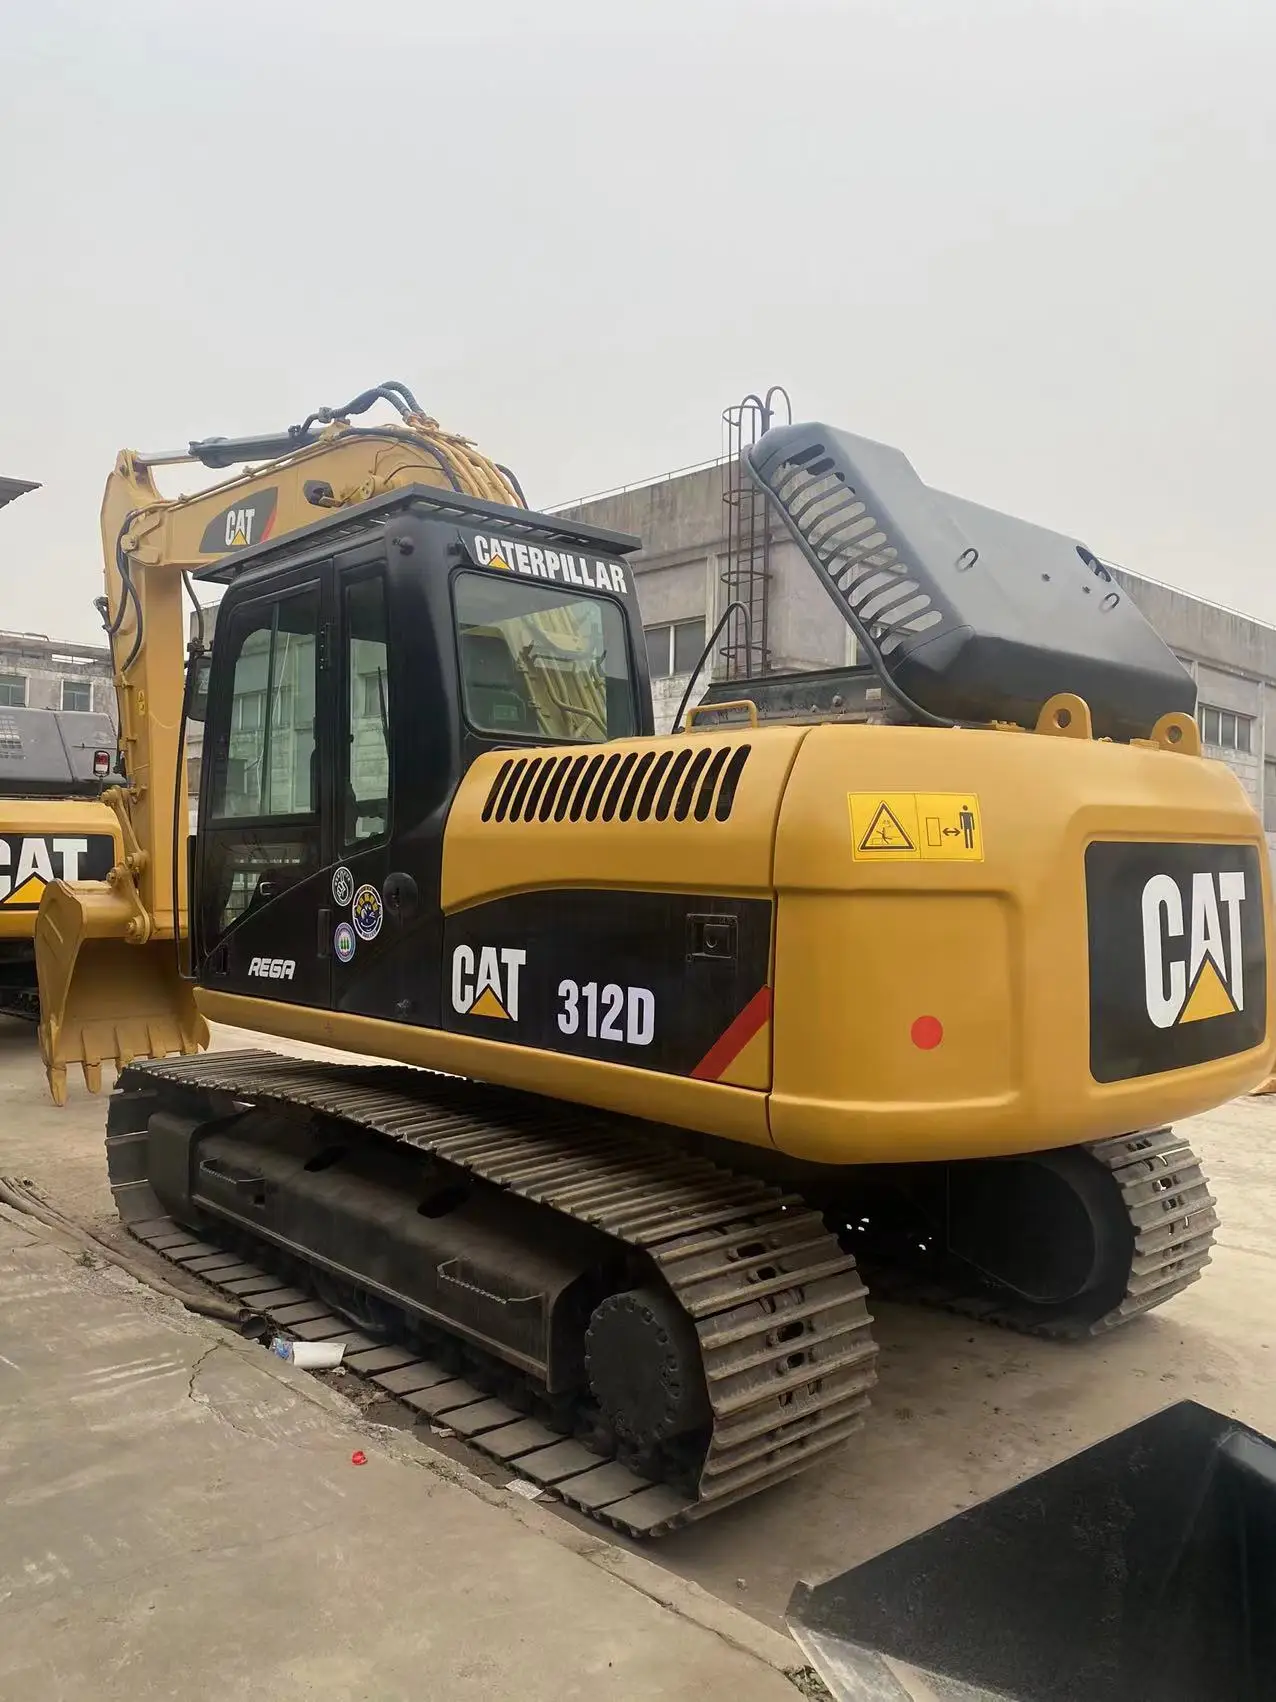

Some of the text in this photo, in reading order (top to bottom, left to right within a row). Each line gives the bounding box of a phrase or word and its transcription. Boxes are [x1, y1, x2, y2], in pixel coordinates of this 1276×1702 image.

[225, 509, 255, 546] CAT
[474, 535, 628, 594] CATERPILLAR
[452, 945, 526, 1022] CAT
[1142, 872, 1246, 1029] CAT
[557, 979, 656, 1046] 312D
